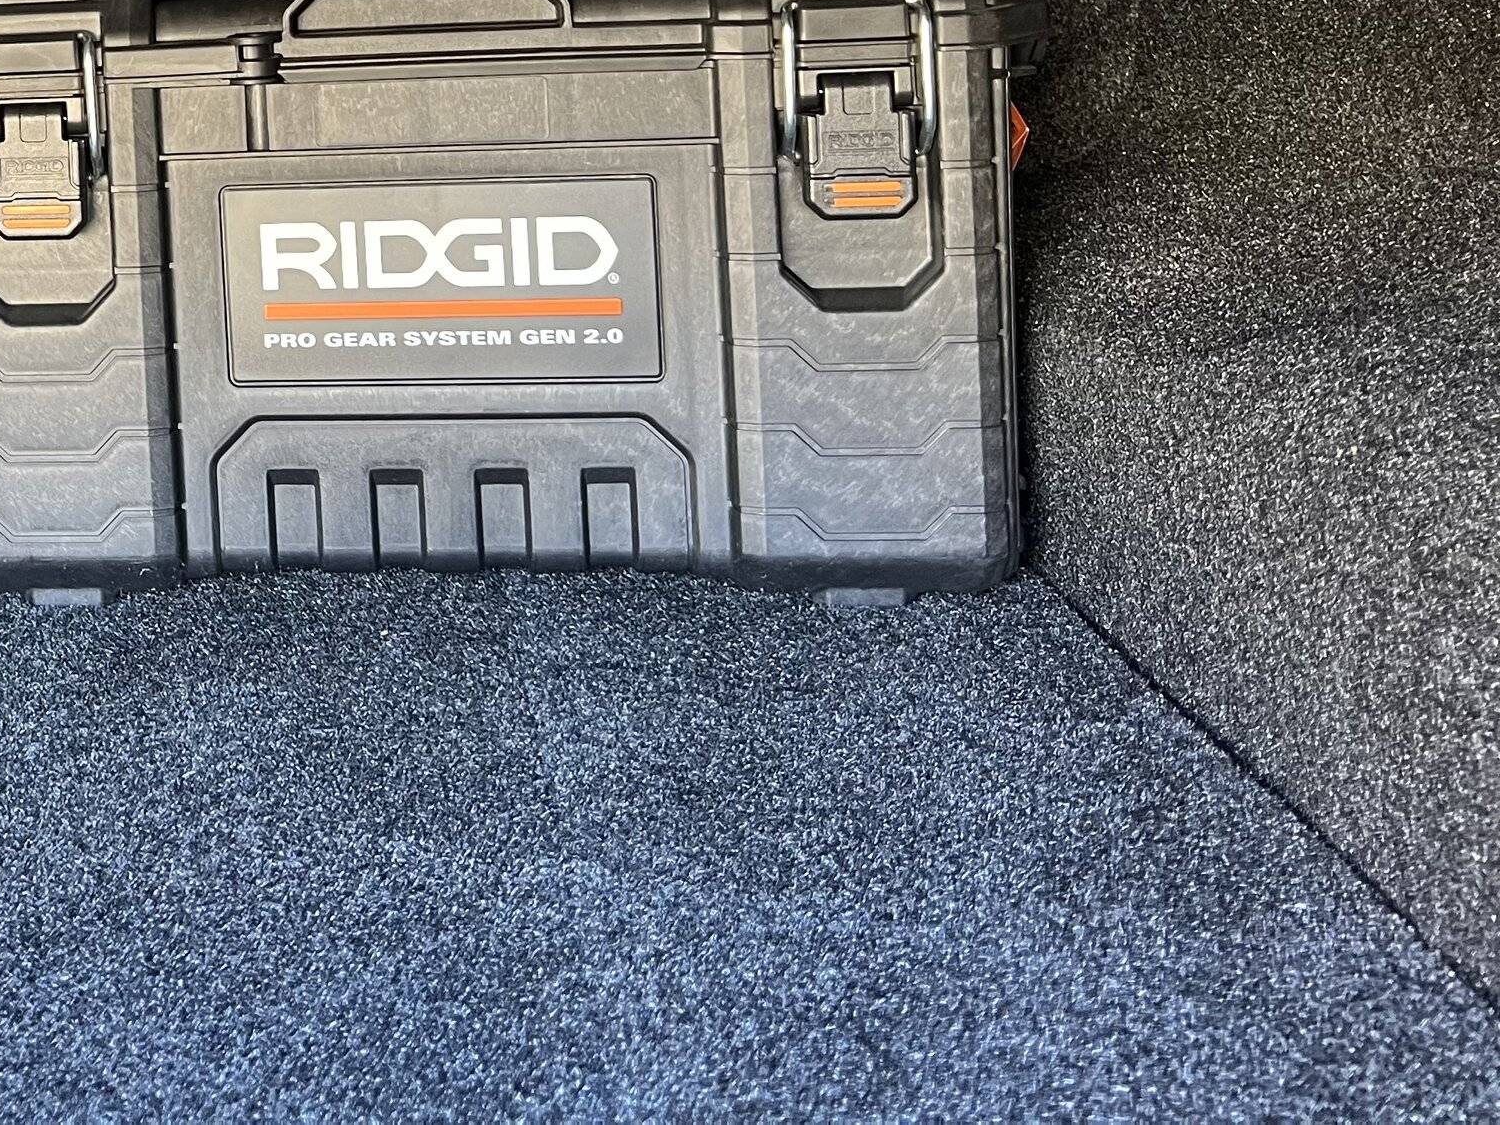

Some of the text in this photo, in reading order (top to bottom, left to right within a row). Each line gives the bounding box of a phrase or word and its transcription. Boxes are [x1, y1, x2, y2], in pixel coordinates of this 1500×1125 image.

[259, 215, 619, 291] RIDGID
[263, 327, 624, 349] PRO GEAR SYSTEM GEN 2.0
